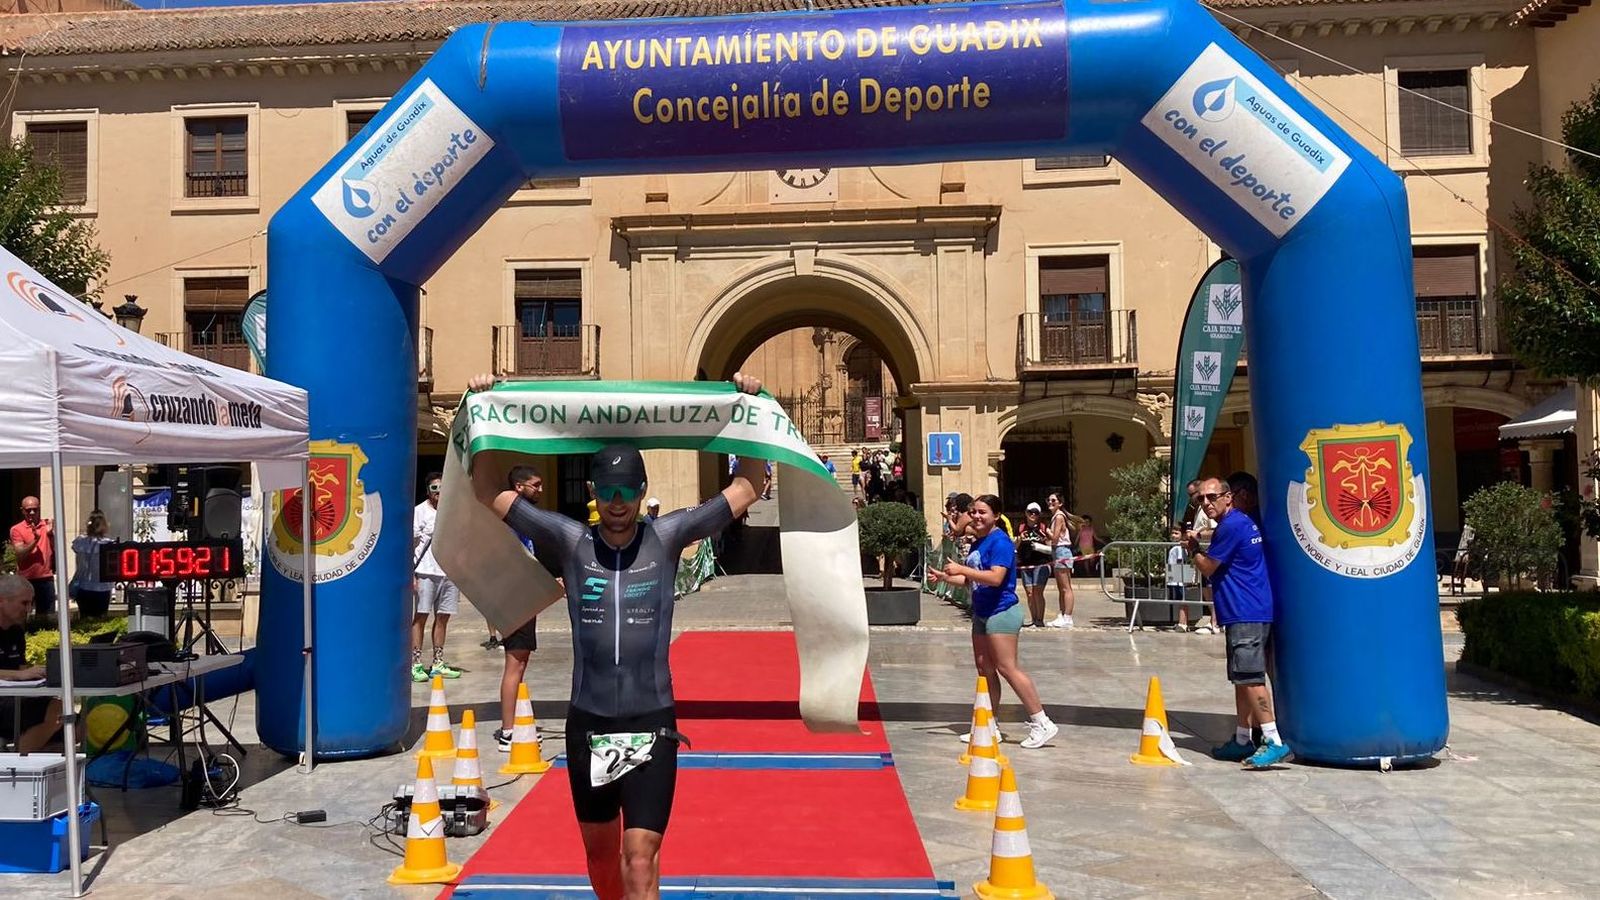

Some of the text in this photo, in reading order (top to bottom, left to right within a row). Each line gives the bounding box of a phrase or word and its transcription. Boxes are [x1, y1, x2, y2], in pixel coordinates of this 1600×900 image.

[581, 18, 1043, 70] AYUNTAMIENTO DE GUADIX
[633, 81, 801, 129] Concejalía
[860, 76, 991, 121] Deporte
[1246, 95, 1325, 164] Aguas de Guadix
[360, 100, 427, 170] Aguas de Guadix
[1164, 109, 1295, 220] con el deporte
[367, 129, 477, 244] con el deporte
[577, 404, 720, 425] ANDALUZA
[731, 403, 760, 426] DE
[771, 411, 805, 442] TR
[312, 568, 343, 583] CIUDAD
[345, 560, 358, 571] DE
[357, 532, 378, 561] GUADIX
[1293, 517, 1425, 576] MUY NOBLE Y LEAL CIUDAD DE GUADIX
